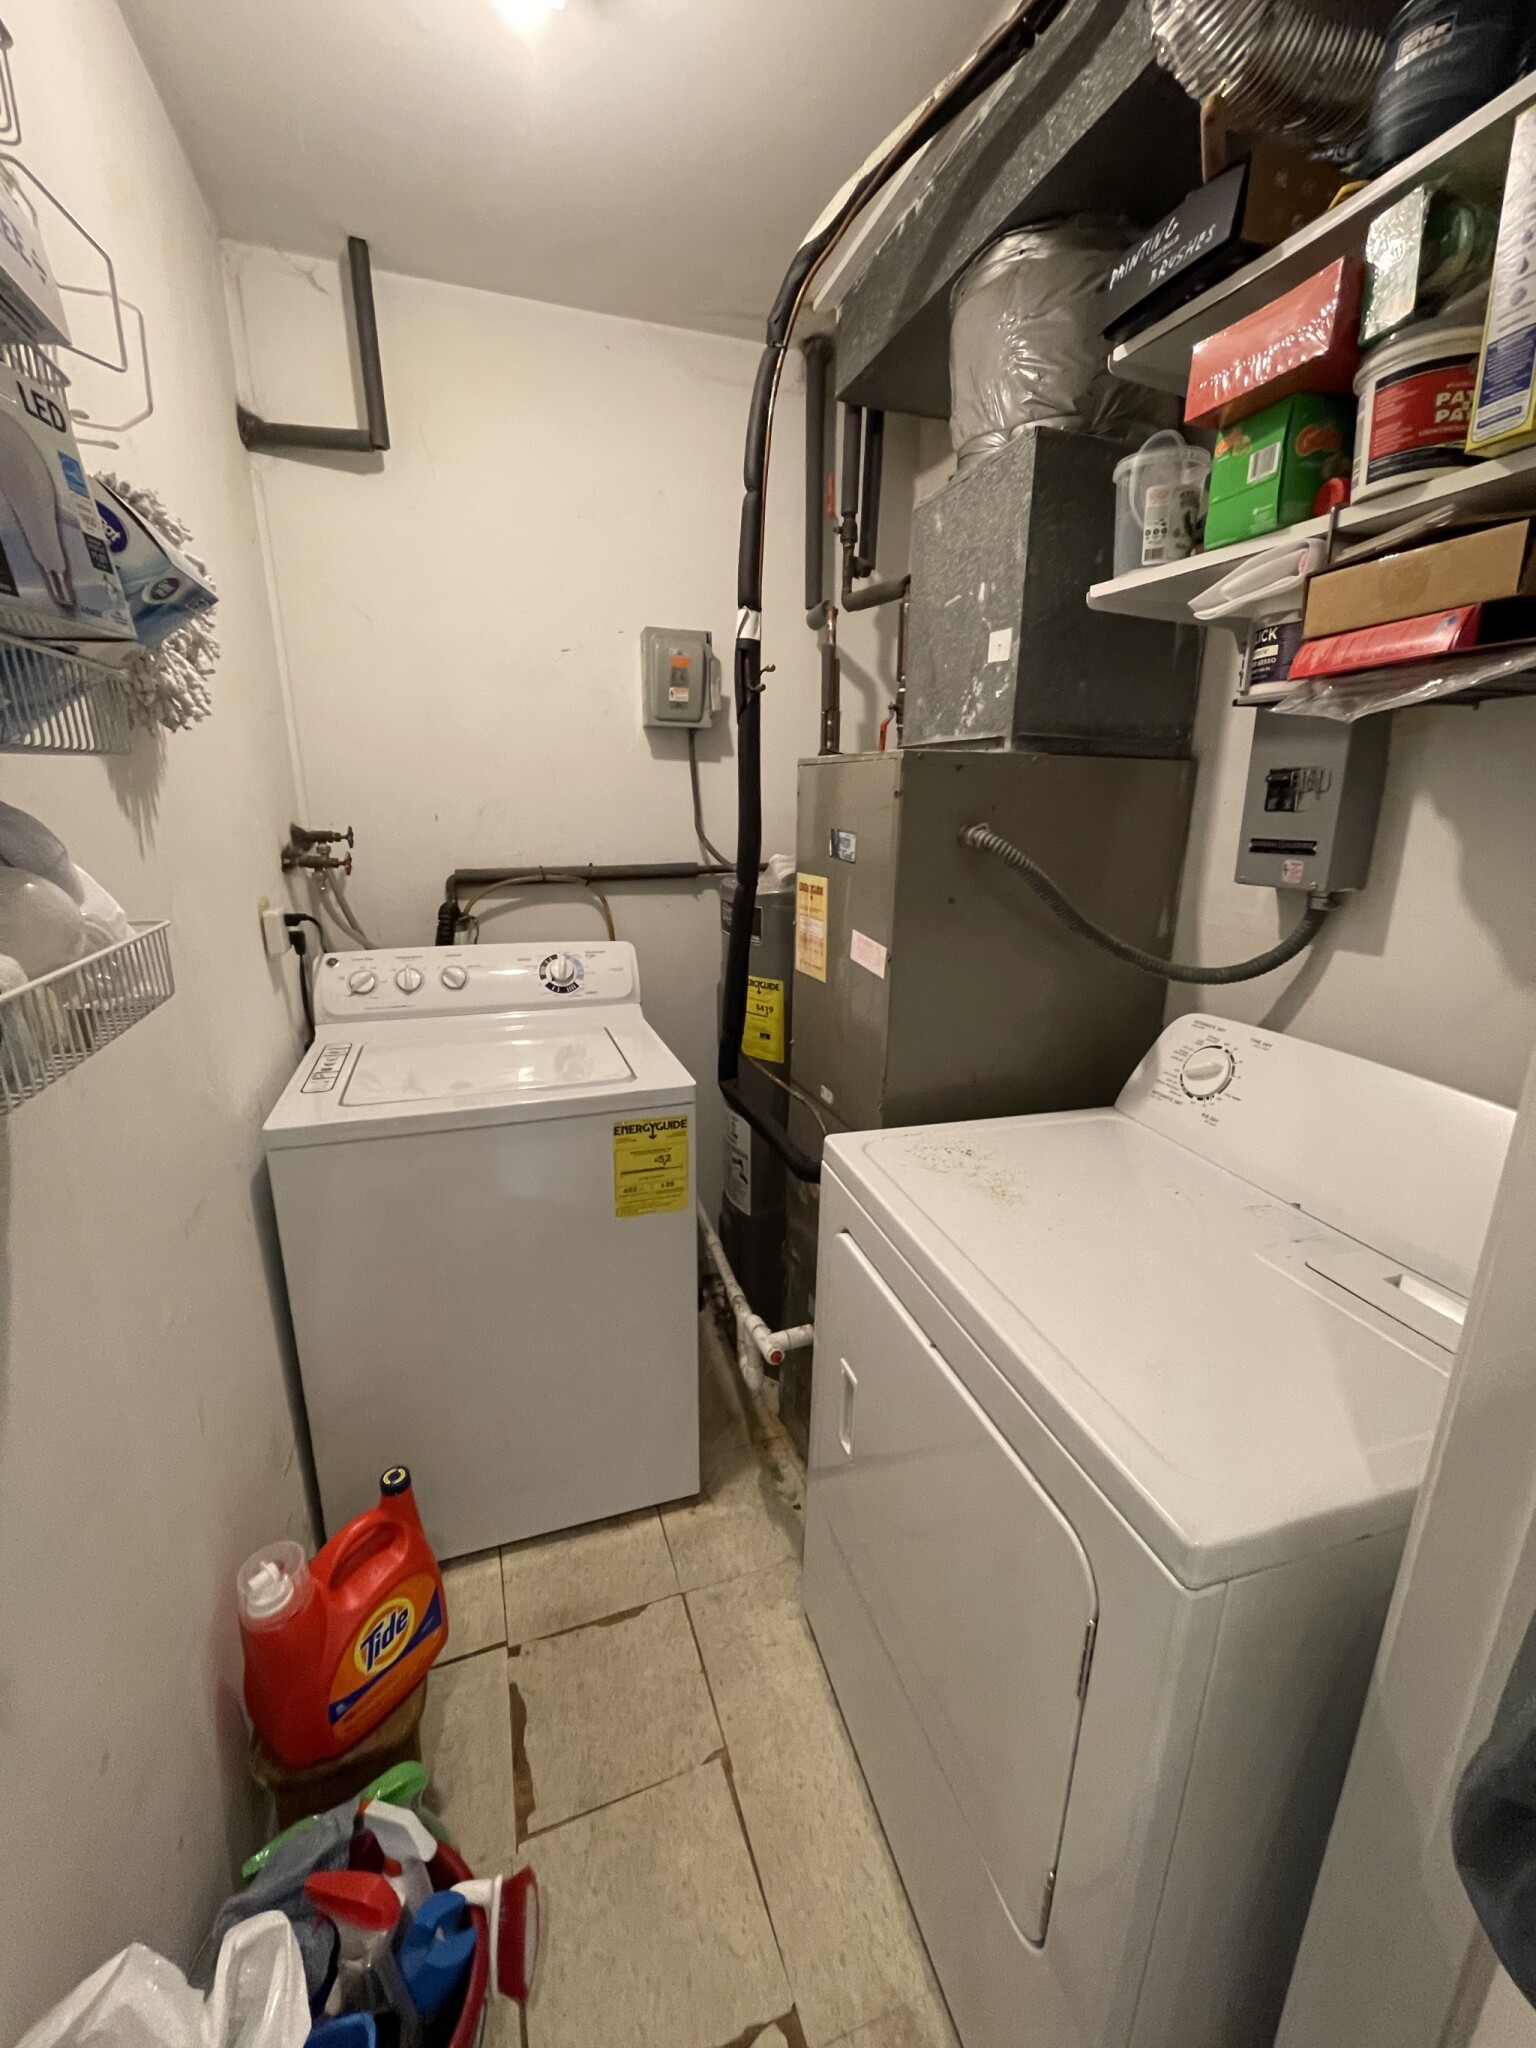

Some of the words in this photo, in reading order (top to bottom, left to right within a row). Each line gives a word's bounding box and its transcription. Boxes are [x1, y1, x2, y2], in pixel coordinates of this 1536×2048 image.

[1108, 216, 1180, 291] PAINTING
[1148, 223, 1217, 286] BRUSHES
[16, 380, 67, 433] LED
[613, 1118, 688, 1138] ENERGYGUIDE
[359, 1606, 409, 1675] Tide
